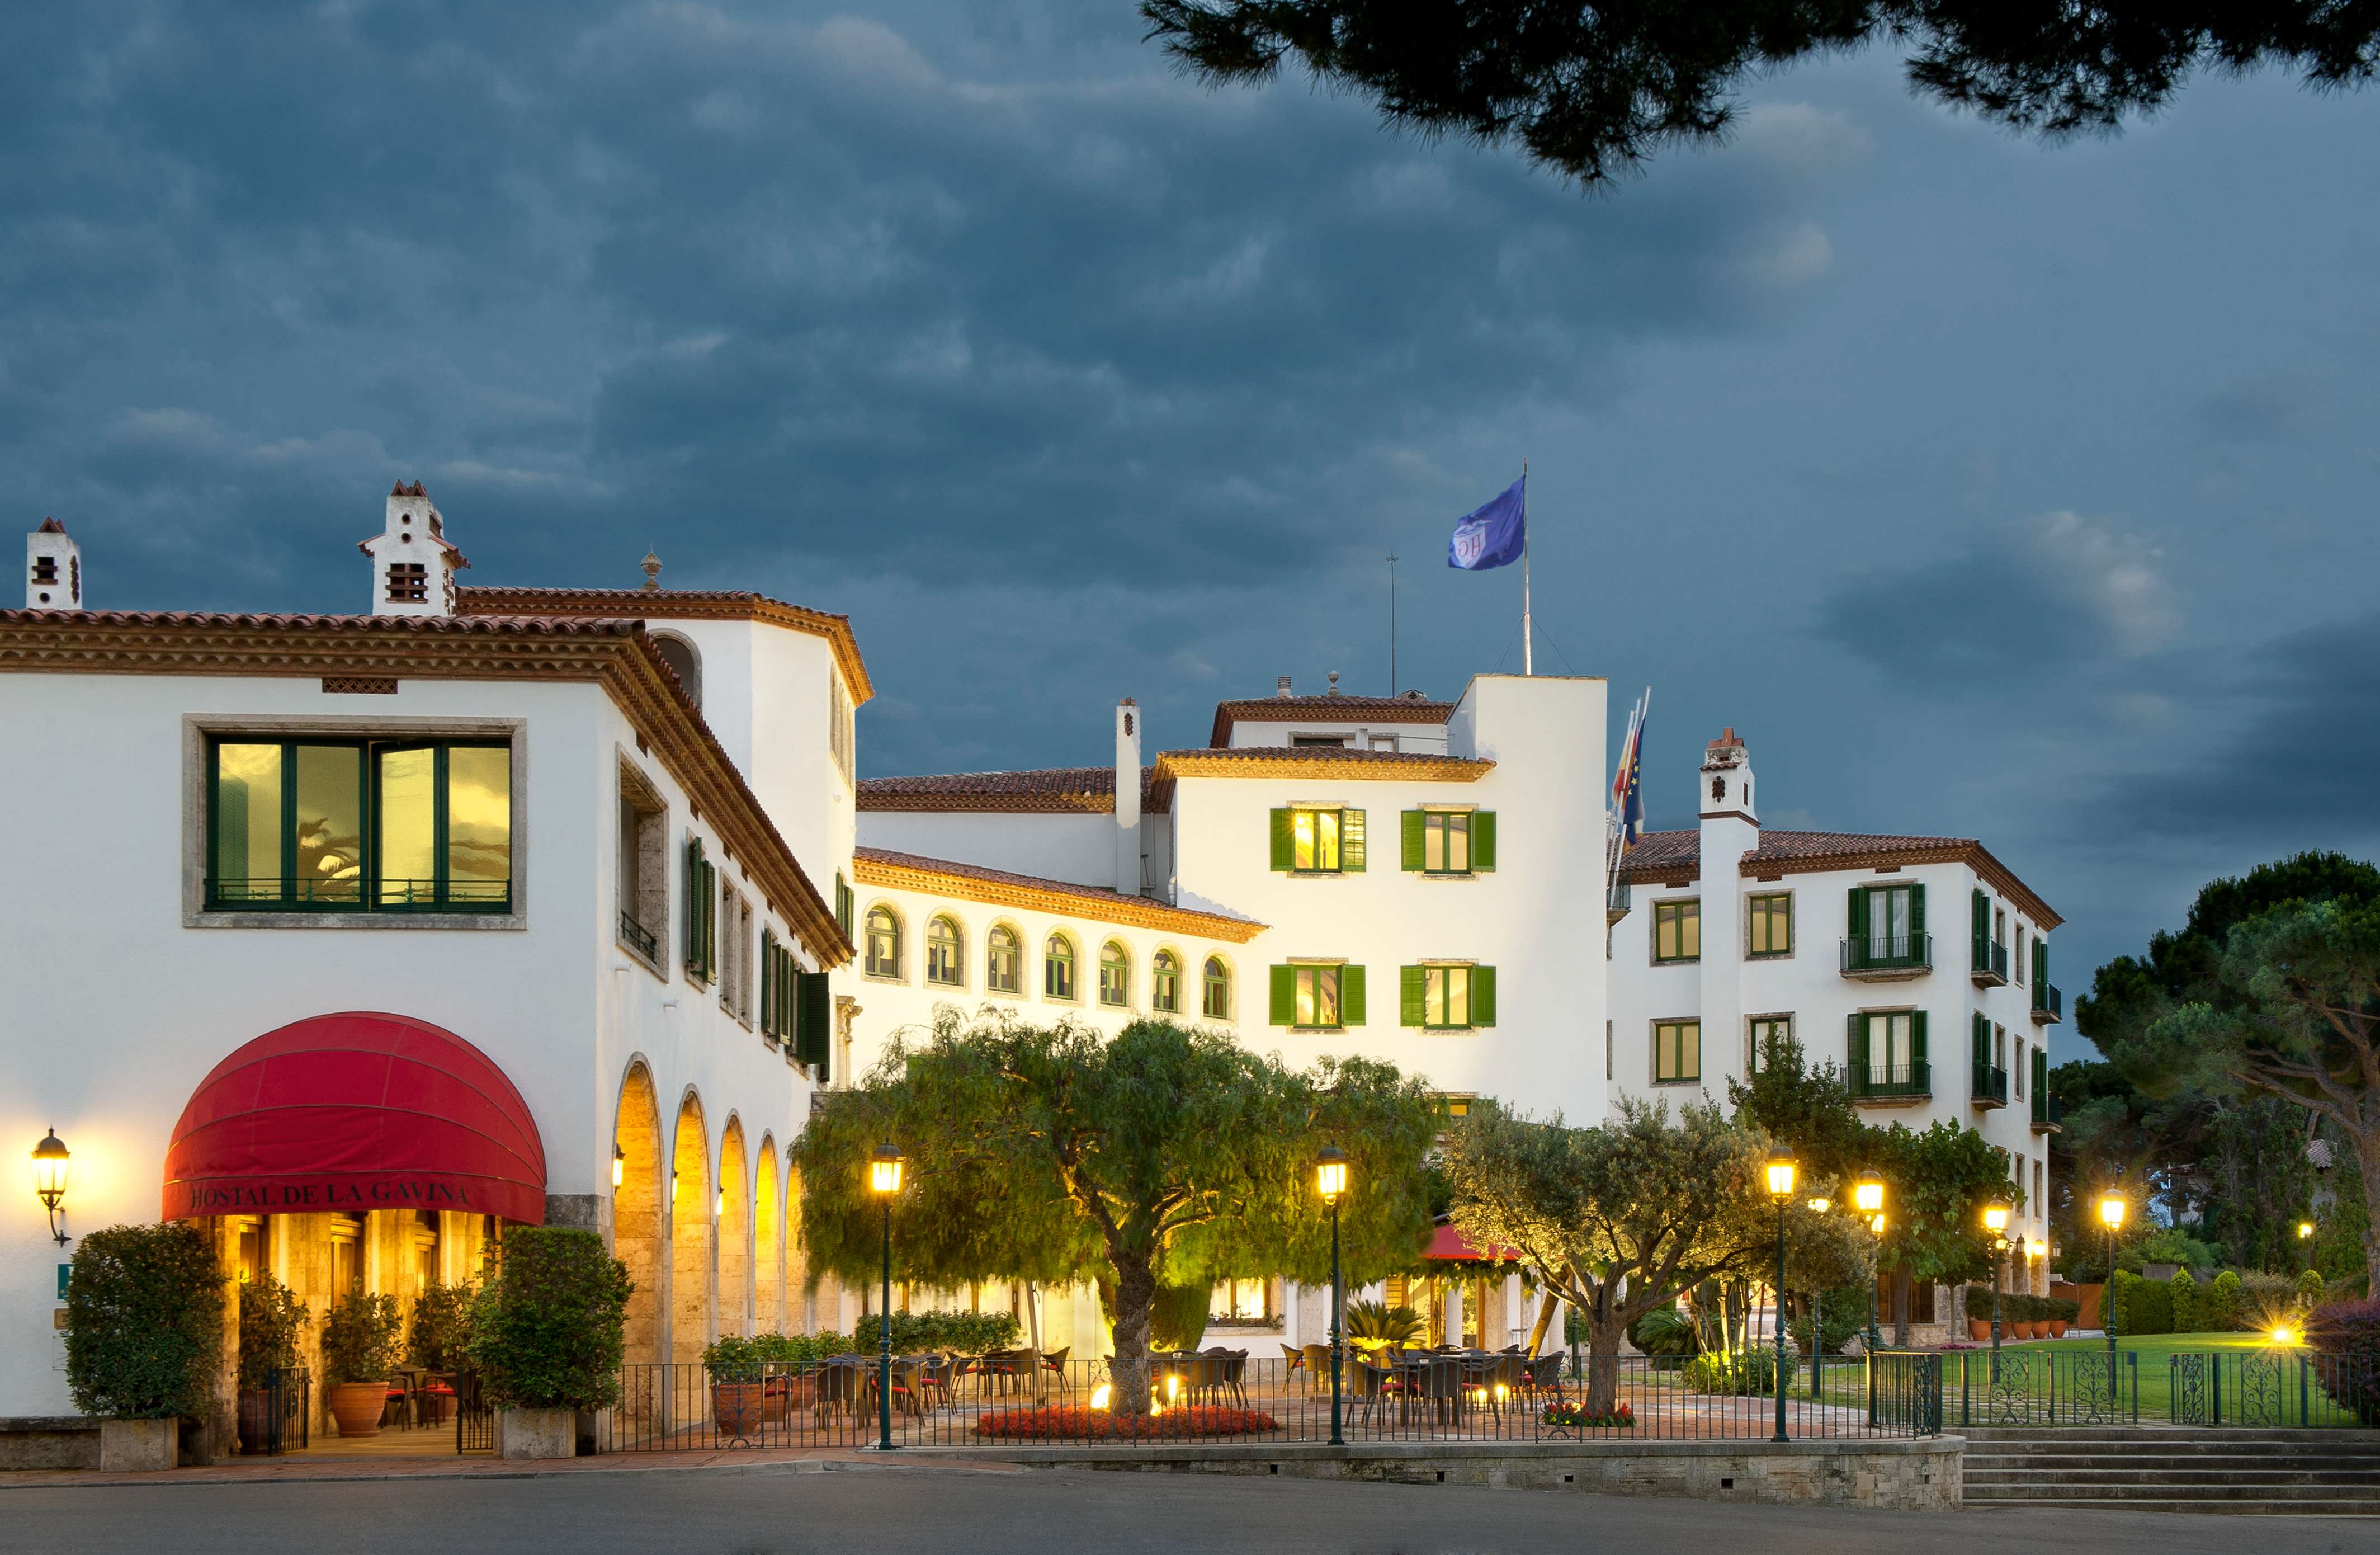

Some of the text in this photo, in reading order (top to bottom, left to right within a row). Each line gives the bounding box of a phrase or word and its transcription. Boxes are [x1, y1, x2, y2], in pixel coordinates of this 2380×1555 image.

[191, 1181, 469, 1208] HOSTAL DE LA GAVINA
